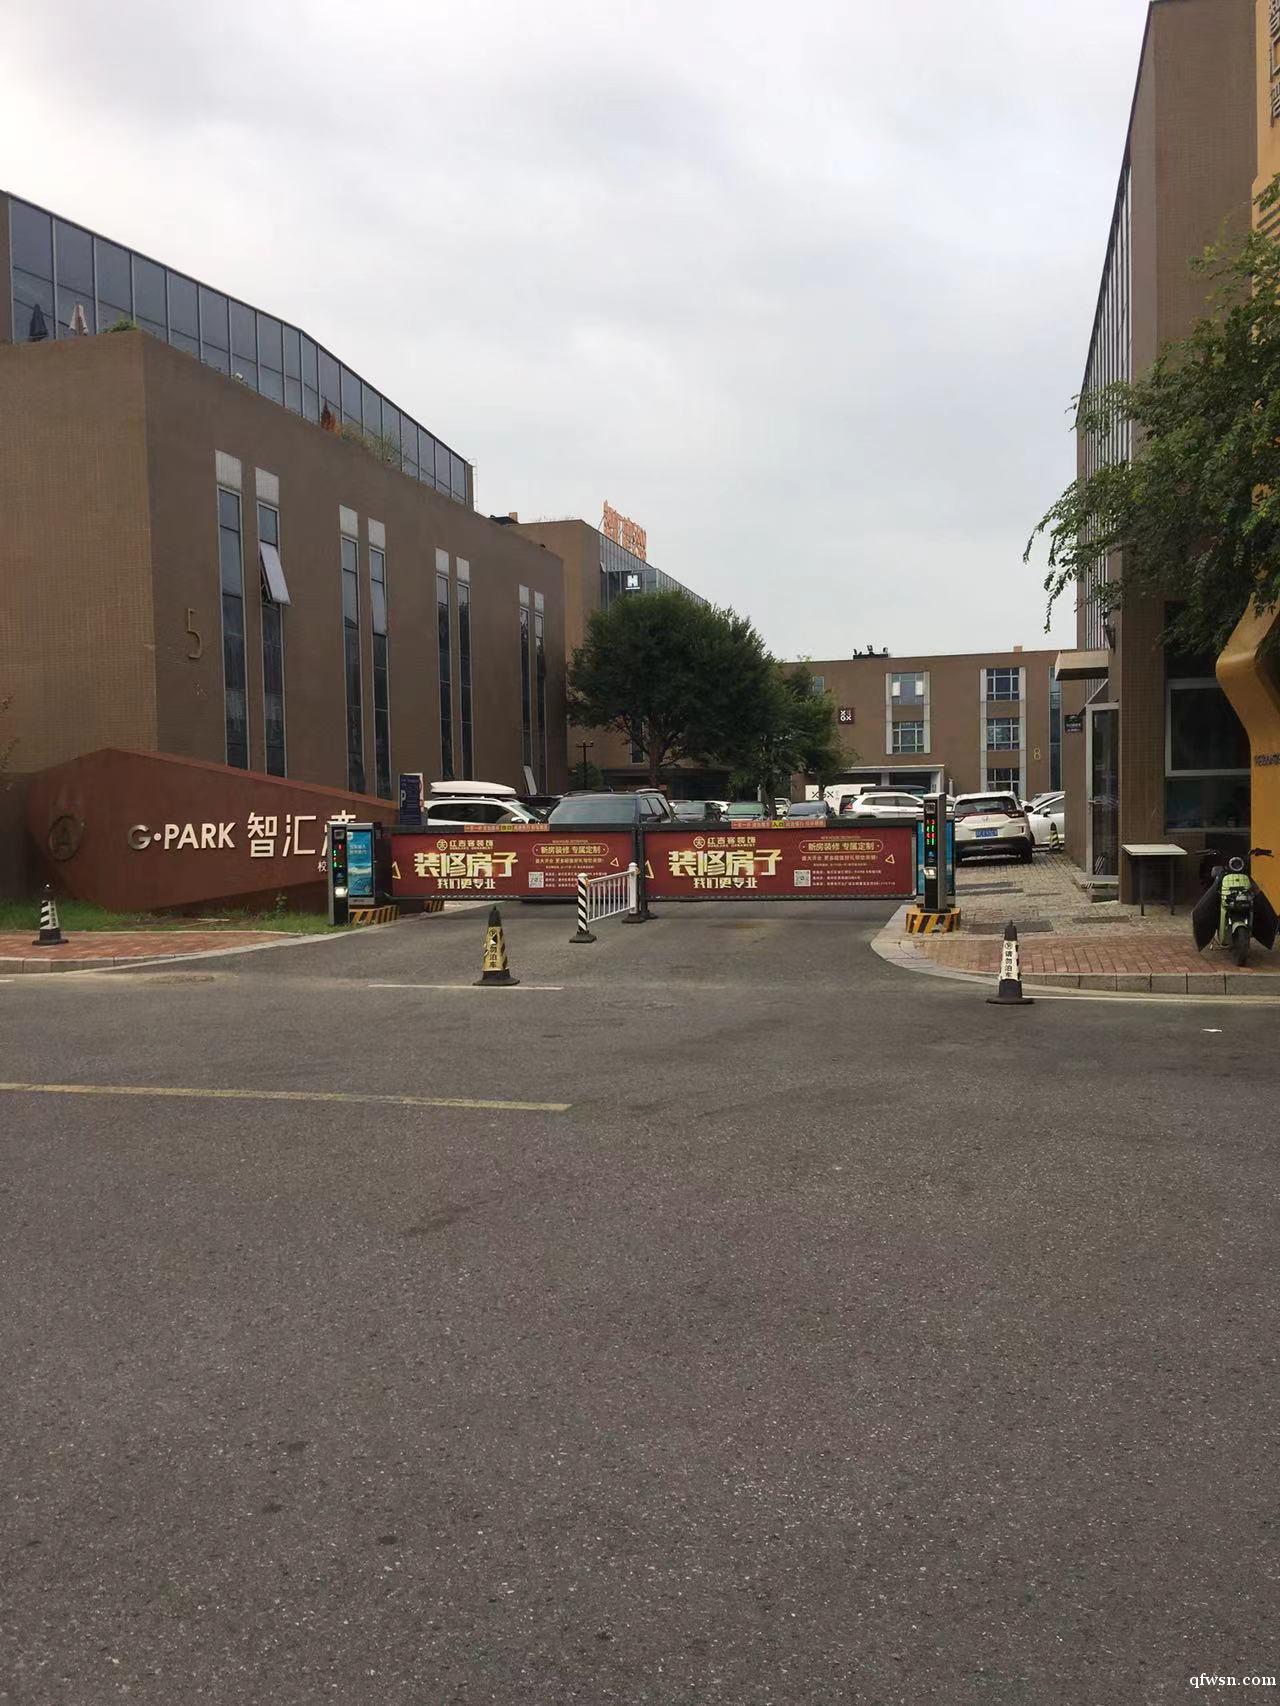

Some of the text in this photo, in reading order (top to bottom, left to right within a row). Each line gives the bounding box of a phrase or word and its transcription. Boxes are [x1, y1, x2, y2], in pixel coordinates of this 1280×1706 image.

[414, 852, 518, 878] 装修房子
[669, 849, 783, 877] 装修房子
[437, 878, 496, 890] 我们更专业
[694, 877, 758, 889] 我们更专业
[1005, 950, 1013, 977] 请勿泊车
